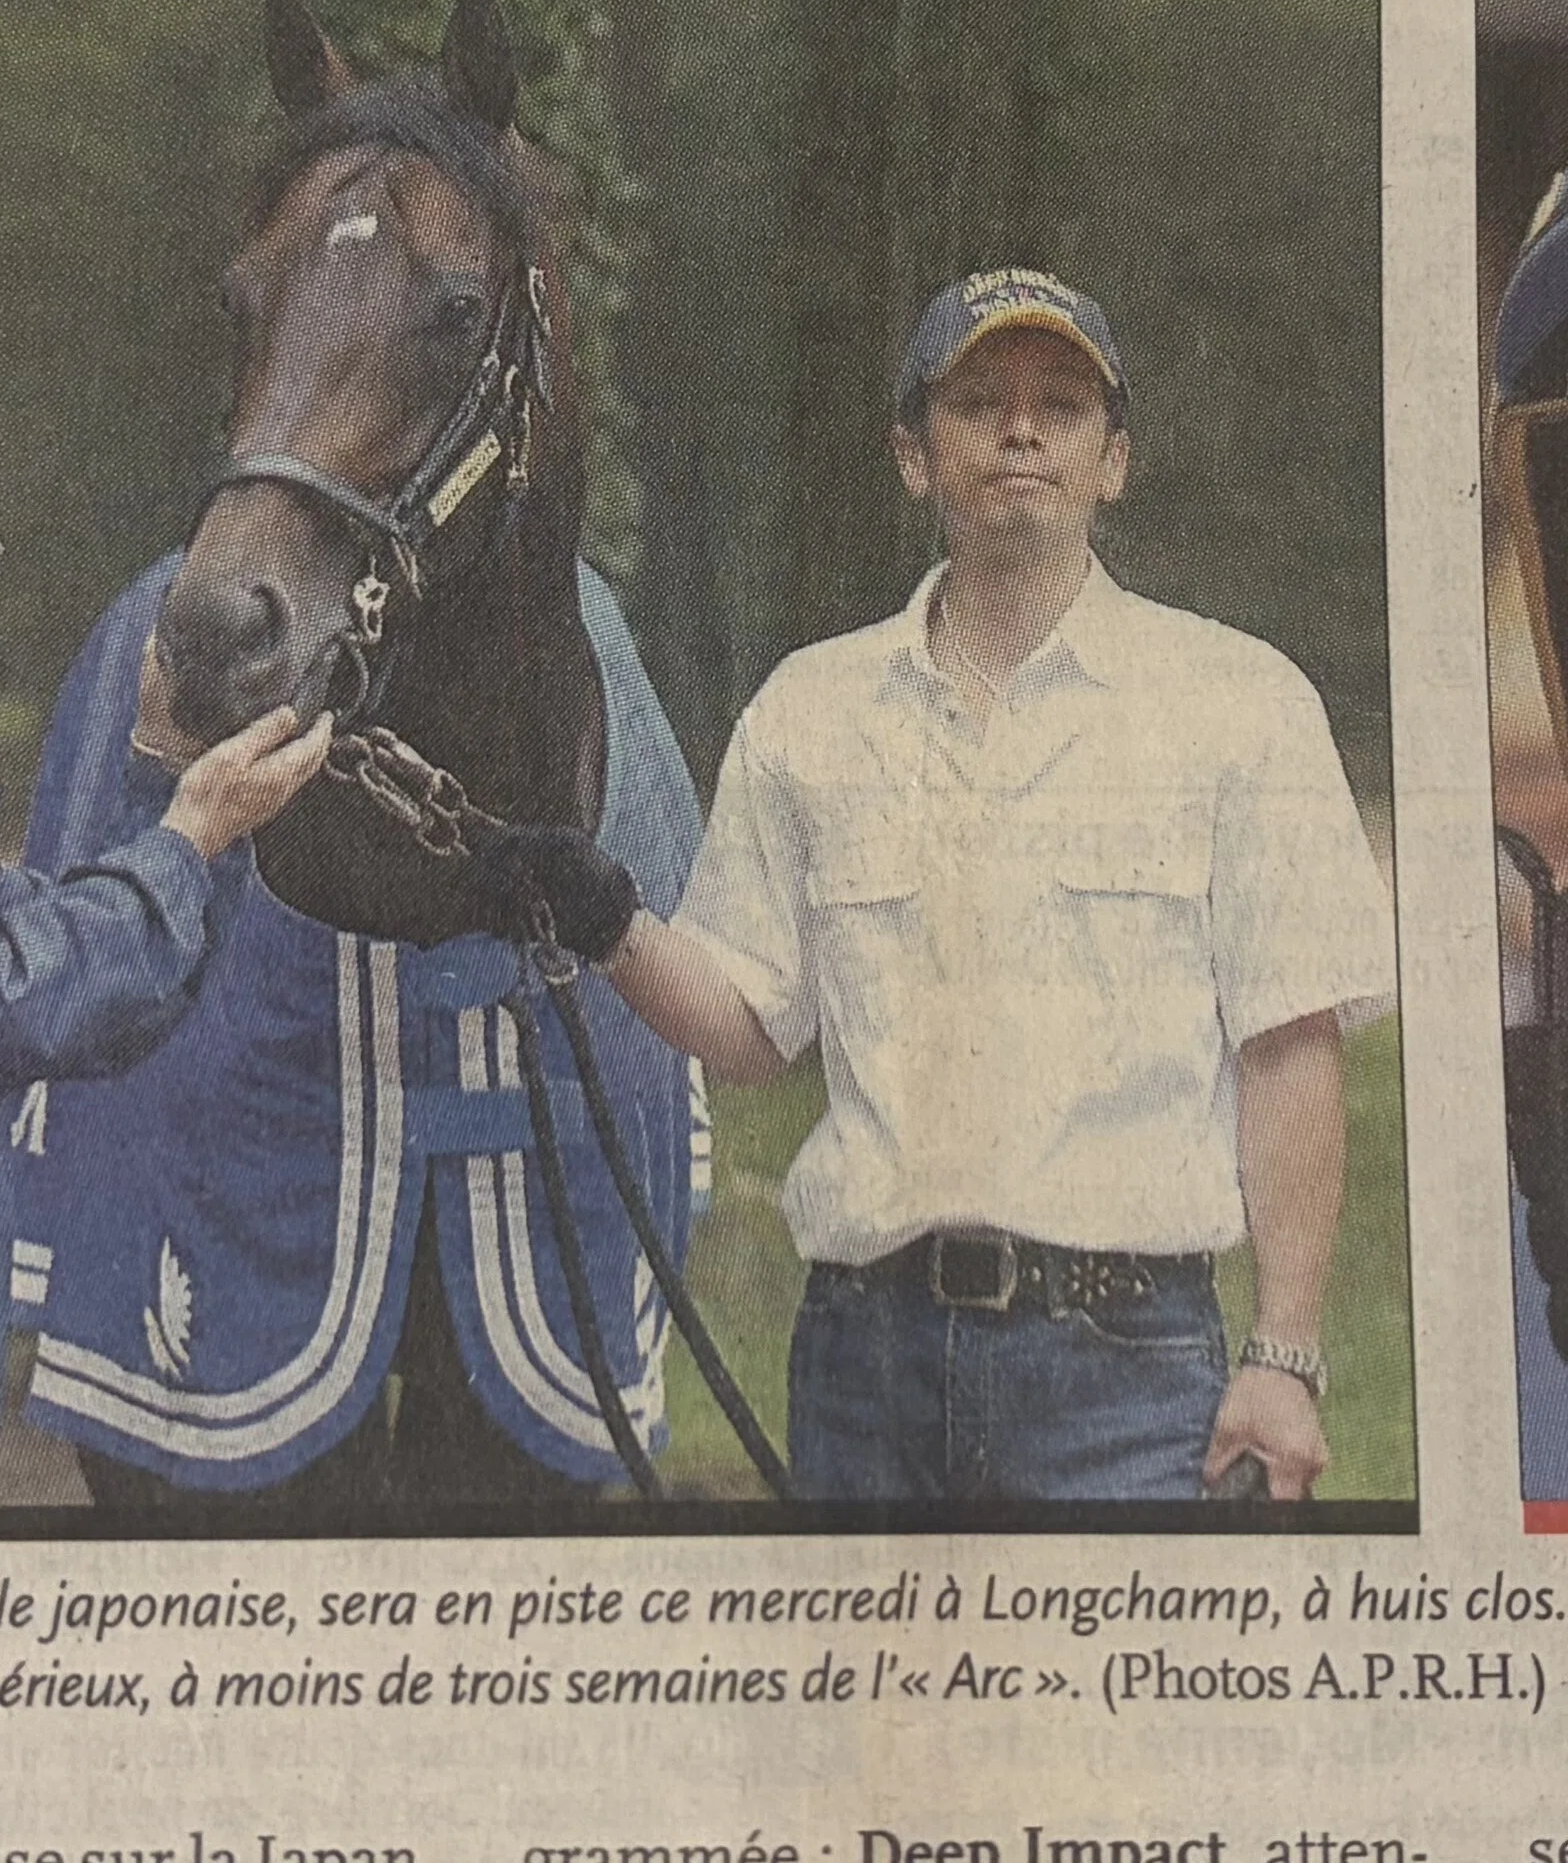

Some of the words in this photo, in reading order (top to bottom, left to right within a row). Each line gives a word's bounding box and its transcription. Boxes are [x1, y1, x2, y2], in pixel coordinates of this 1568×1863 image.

[37, 1578, 297, 1645] japonaise,
[318, 1592, 417, 1627] sera
[435, 1591, 493, 1626] en
[507, 1575, 623, 1640] piste
[640, 1589, 691, 1624] ce
[708, 1570, 921, 1623] mercredi
[934, 1574, 962, 1622] à
[982, 1569, 1281, 1637] Longchamp,
[1302, 1574, 1331, 1622] à
[1350, 1570, 1449, 1622] huis
[1465, 1570, 1566, 1623] clos.
[169, 1659, 199, 1708] à
[215, 1656, 364, 1707] moins
[377, 1653, 434, 1707] de
[449, 1655, 552, 1706] trois
[565, 1654, 788, 1705] semaines
[801, 1650, 856, 1703] de
[942, 1651, 1023, 1700] Arc
[1102, 1648, 1291, 1716] (Photos
[1303, 1652, 1546, 1715] A.P.R.H.)
